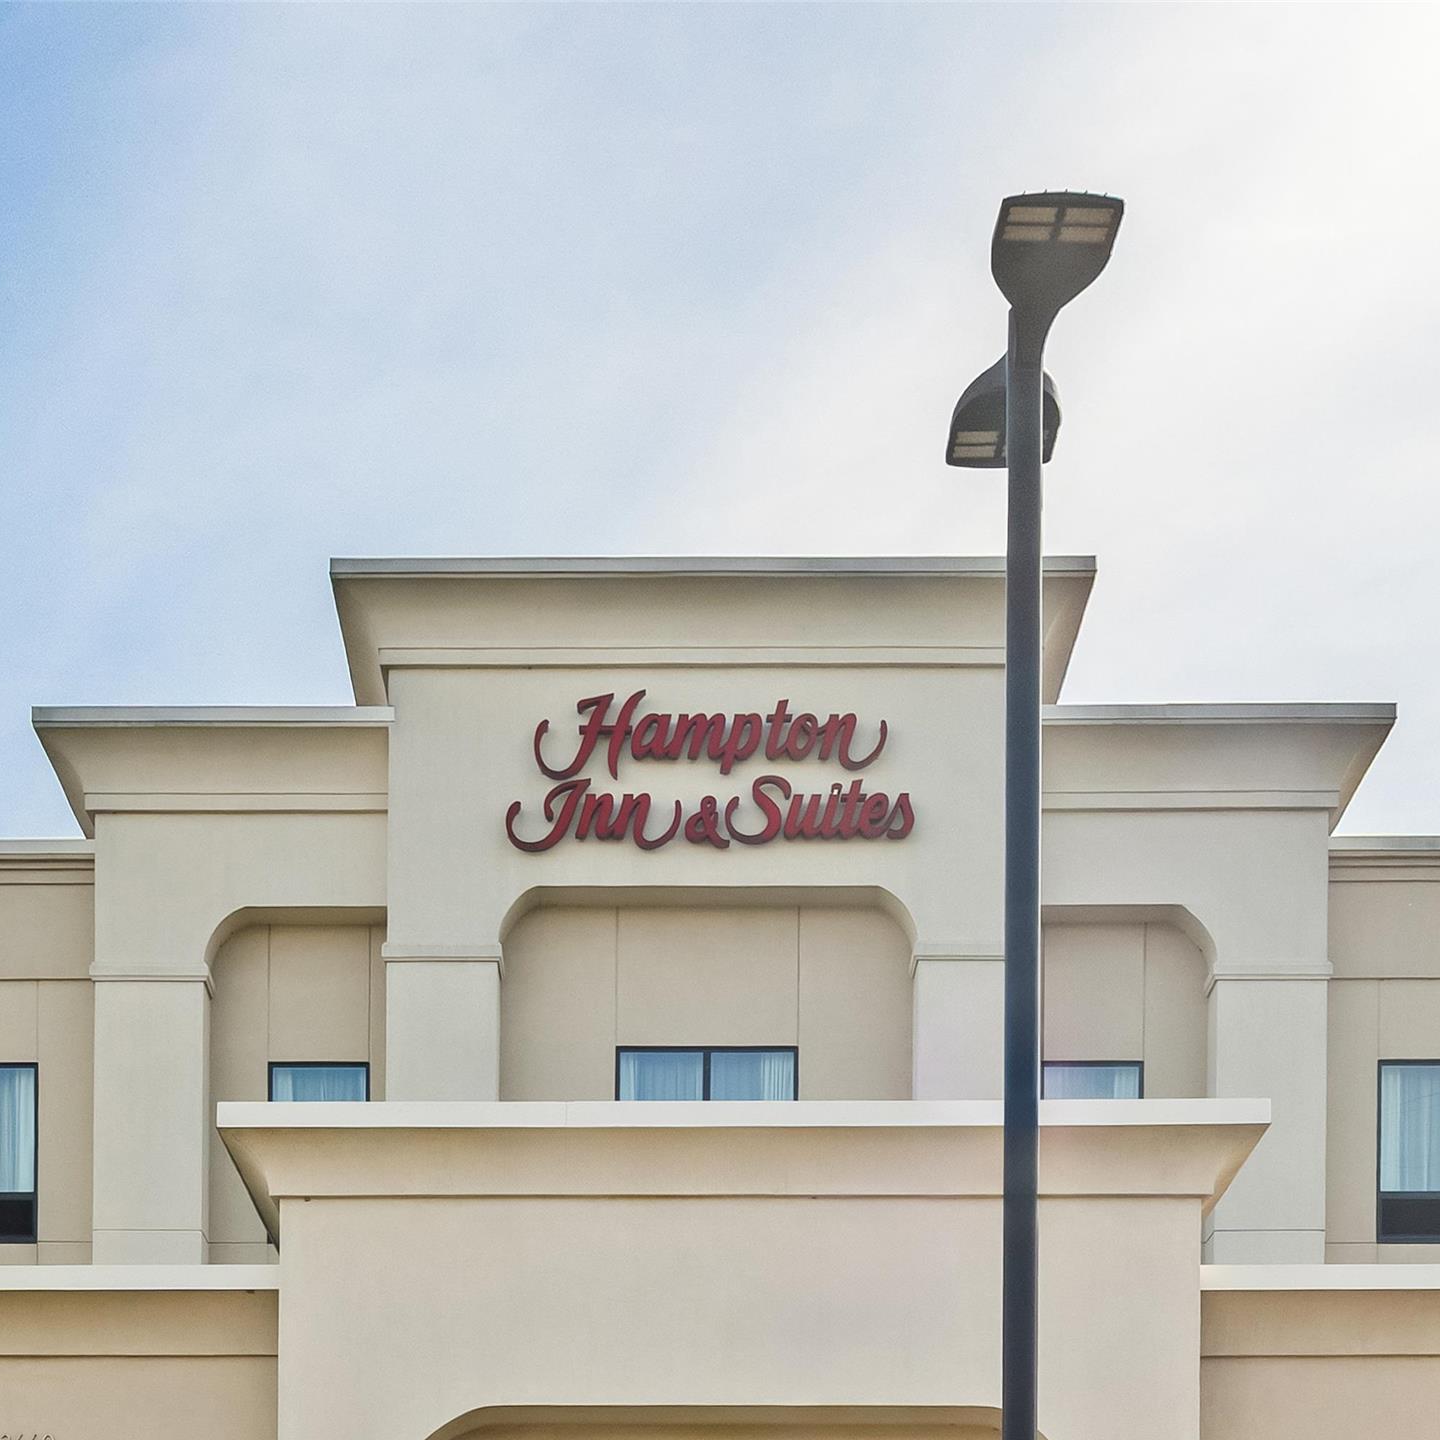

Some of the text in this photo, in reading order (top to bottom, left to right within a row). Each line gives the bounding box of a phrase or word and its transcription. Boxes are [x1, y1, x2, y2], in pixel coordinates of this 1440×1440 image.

[534, 689, 888, 781] Hampton
[505, 775, 915, 853] Inn & Suites
